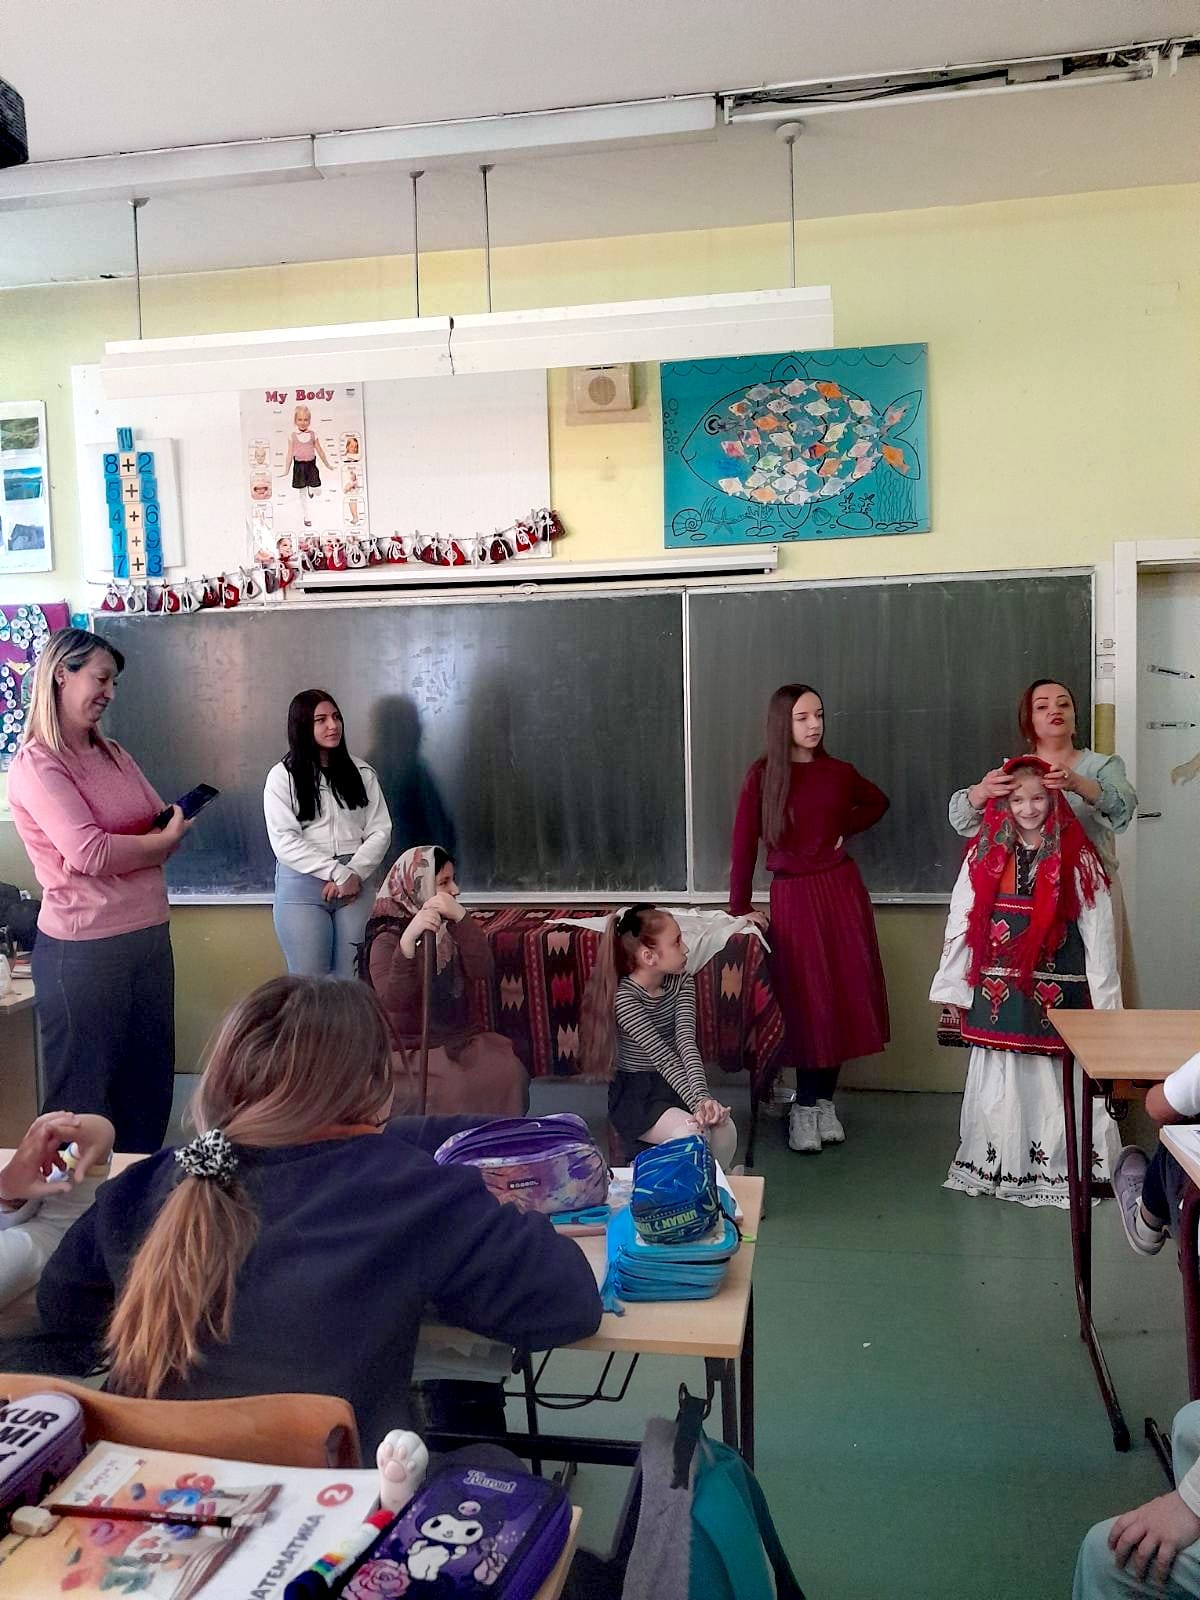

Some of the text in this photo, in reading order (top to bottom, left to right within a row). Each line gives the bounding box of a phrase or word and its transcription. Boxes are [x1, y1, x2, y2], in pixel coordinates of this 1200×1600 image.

[265, 391, 288, 404] My
[295, 388, 335, 401] Body
[105, 454, 119, 474] 8
[138, 453, 153, 473] 2
[109, 481, 120, 497] 5
[112, 509, 122, 524] 4
[145, 504, 159, 524] 6
[147, 530, 161, 549] 9
[115, 556, 126, 575] 7
[149, 555, 162, 574] 3
[324, 1489, 348, 1501] 2
